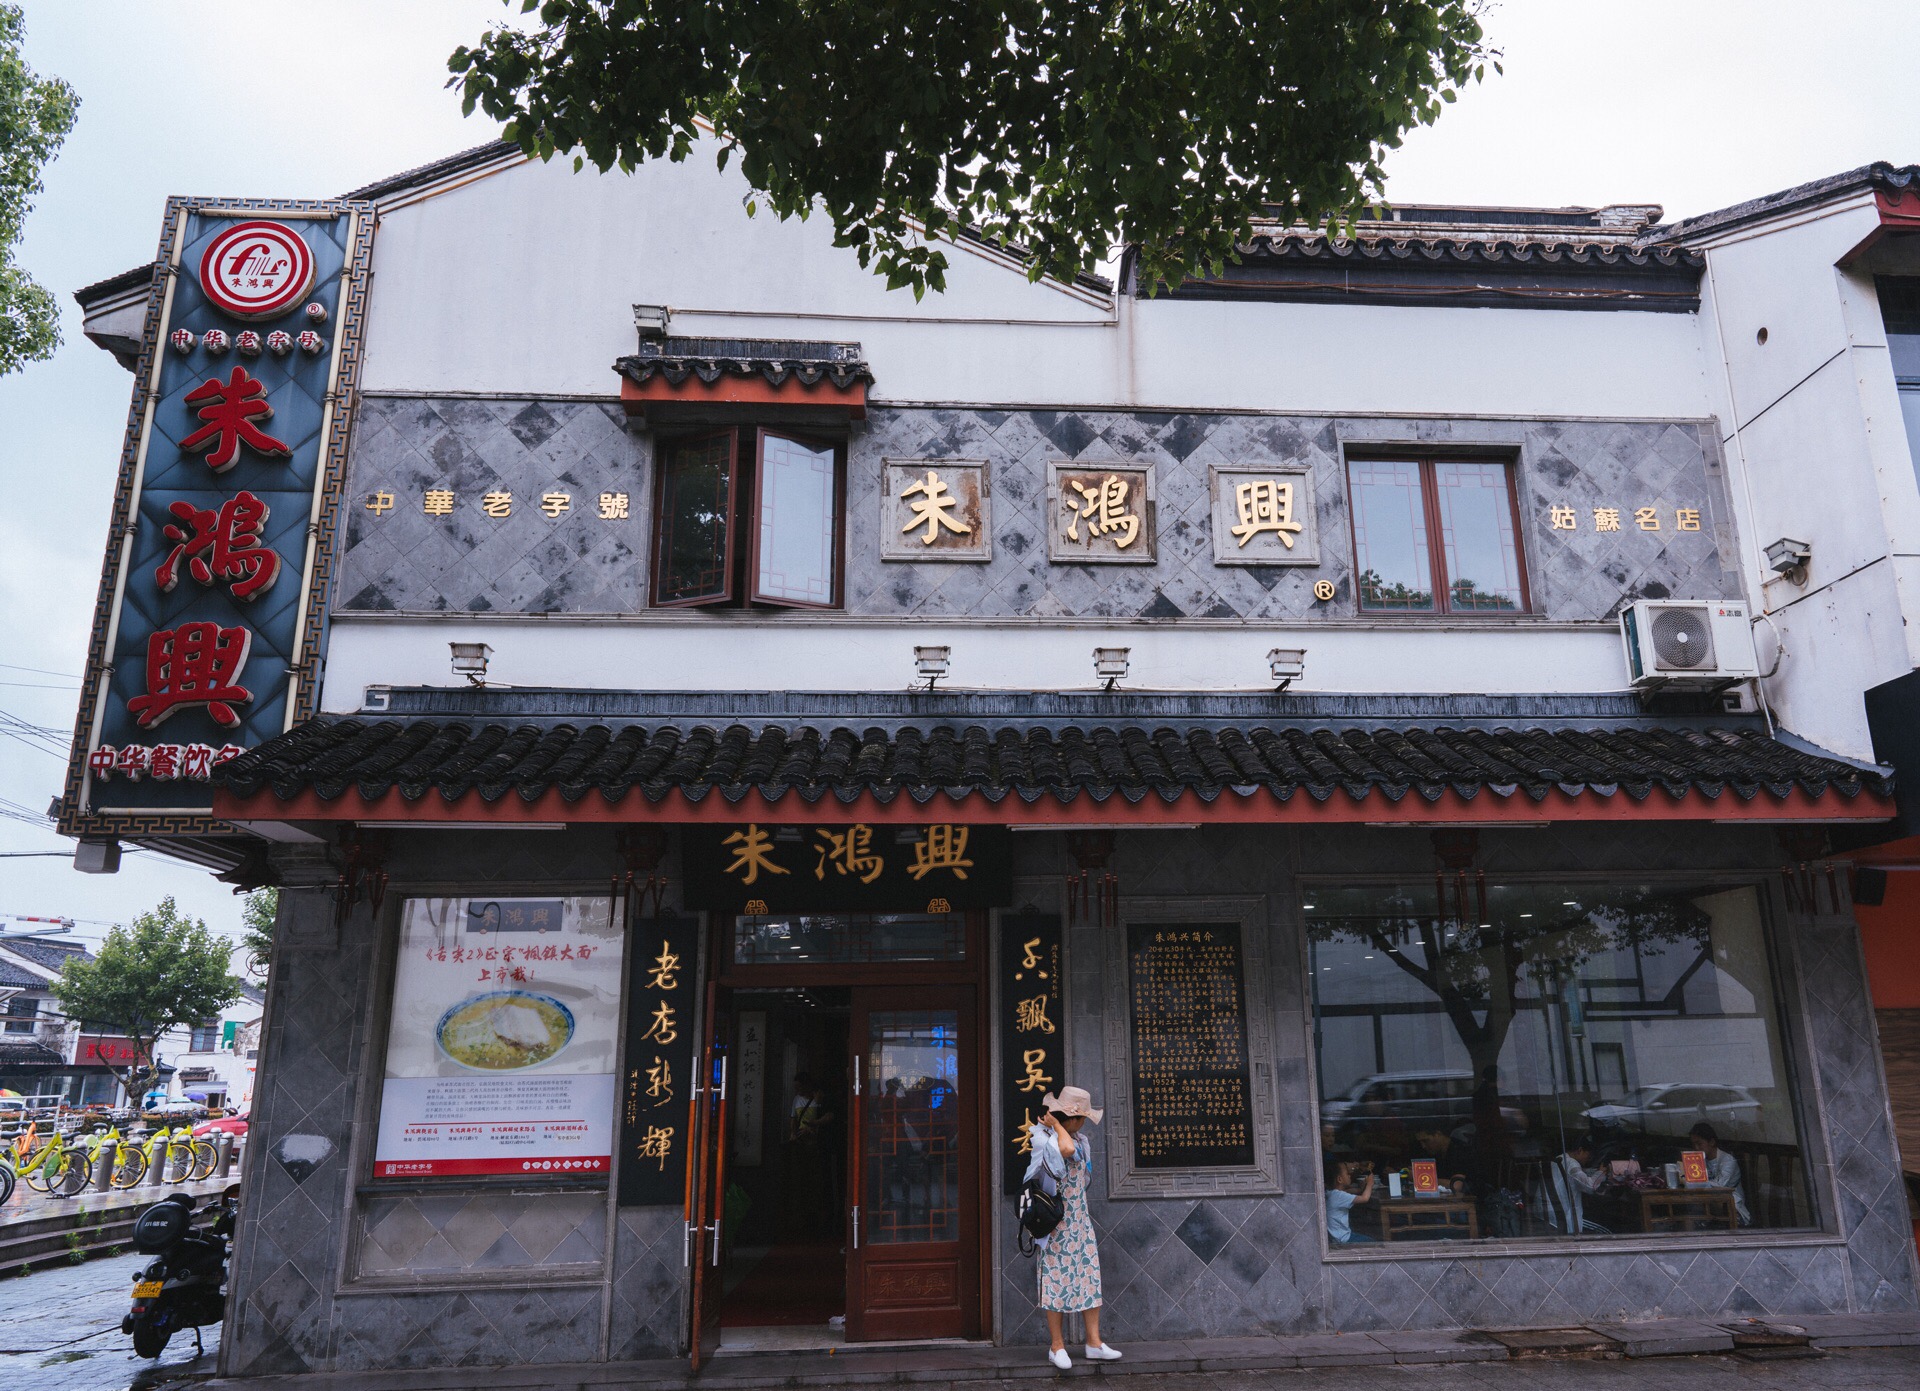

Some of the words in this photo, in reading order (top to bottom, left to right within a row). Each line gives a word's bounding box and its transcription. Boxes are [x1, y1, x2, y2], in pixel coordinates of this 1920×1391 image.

[231, 277, 274, 289] 朱鴻興
[171, 329, 316, 348] 中华老字号
[366, 489, 630, 520] 中華老字號
[900, 470, 1302, 549] 朱鴻興
[1550, 505, 1701, 532] 姑蘇名店
[128, 366, 292, 730] 朱鴻興
[720, 823, 975, 886] 朱鴻興
[1155, 931, 1214, 943] 朱鸿兴简介
[1421, 1174, 1431, 1187] 2
[1691, 1163, 1701, 1179] 3
